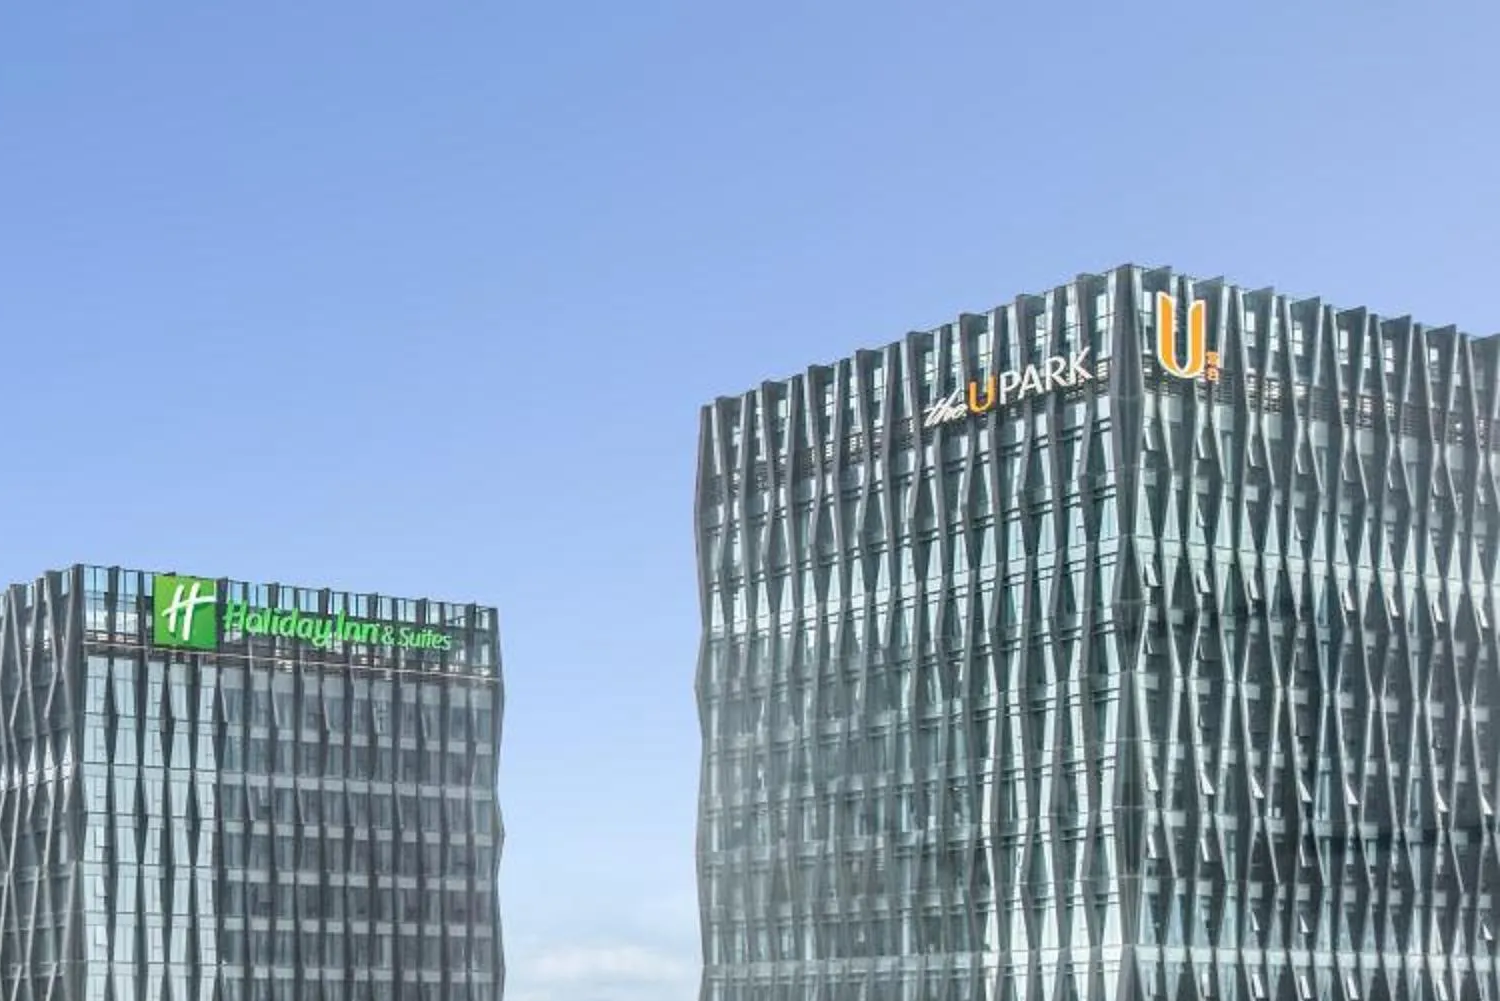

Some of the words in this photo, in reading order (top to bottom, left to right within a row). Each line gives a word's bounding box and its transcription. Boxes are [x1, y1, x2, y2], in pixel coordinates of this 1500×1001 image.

[223, 598, 331, 649] Holiday
[335, 608, 381, 645] Inn
[382, 624, 395, 646] &
[398, 627, 453, 650] Suites
